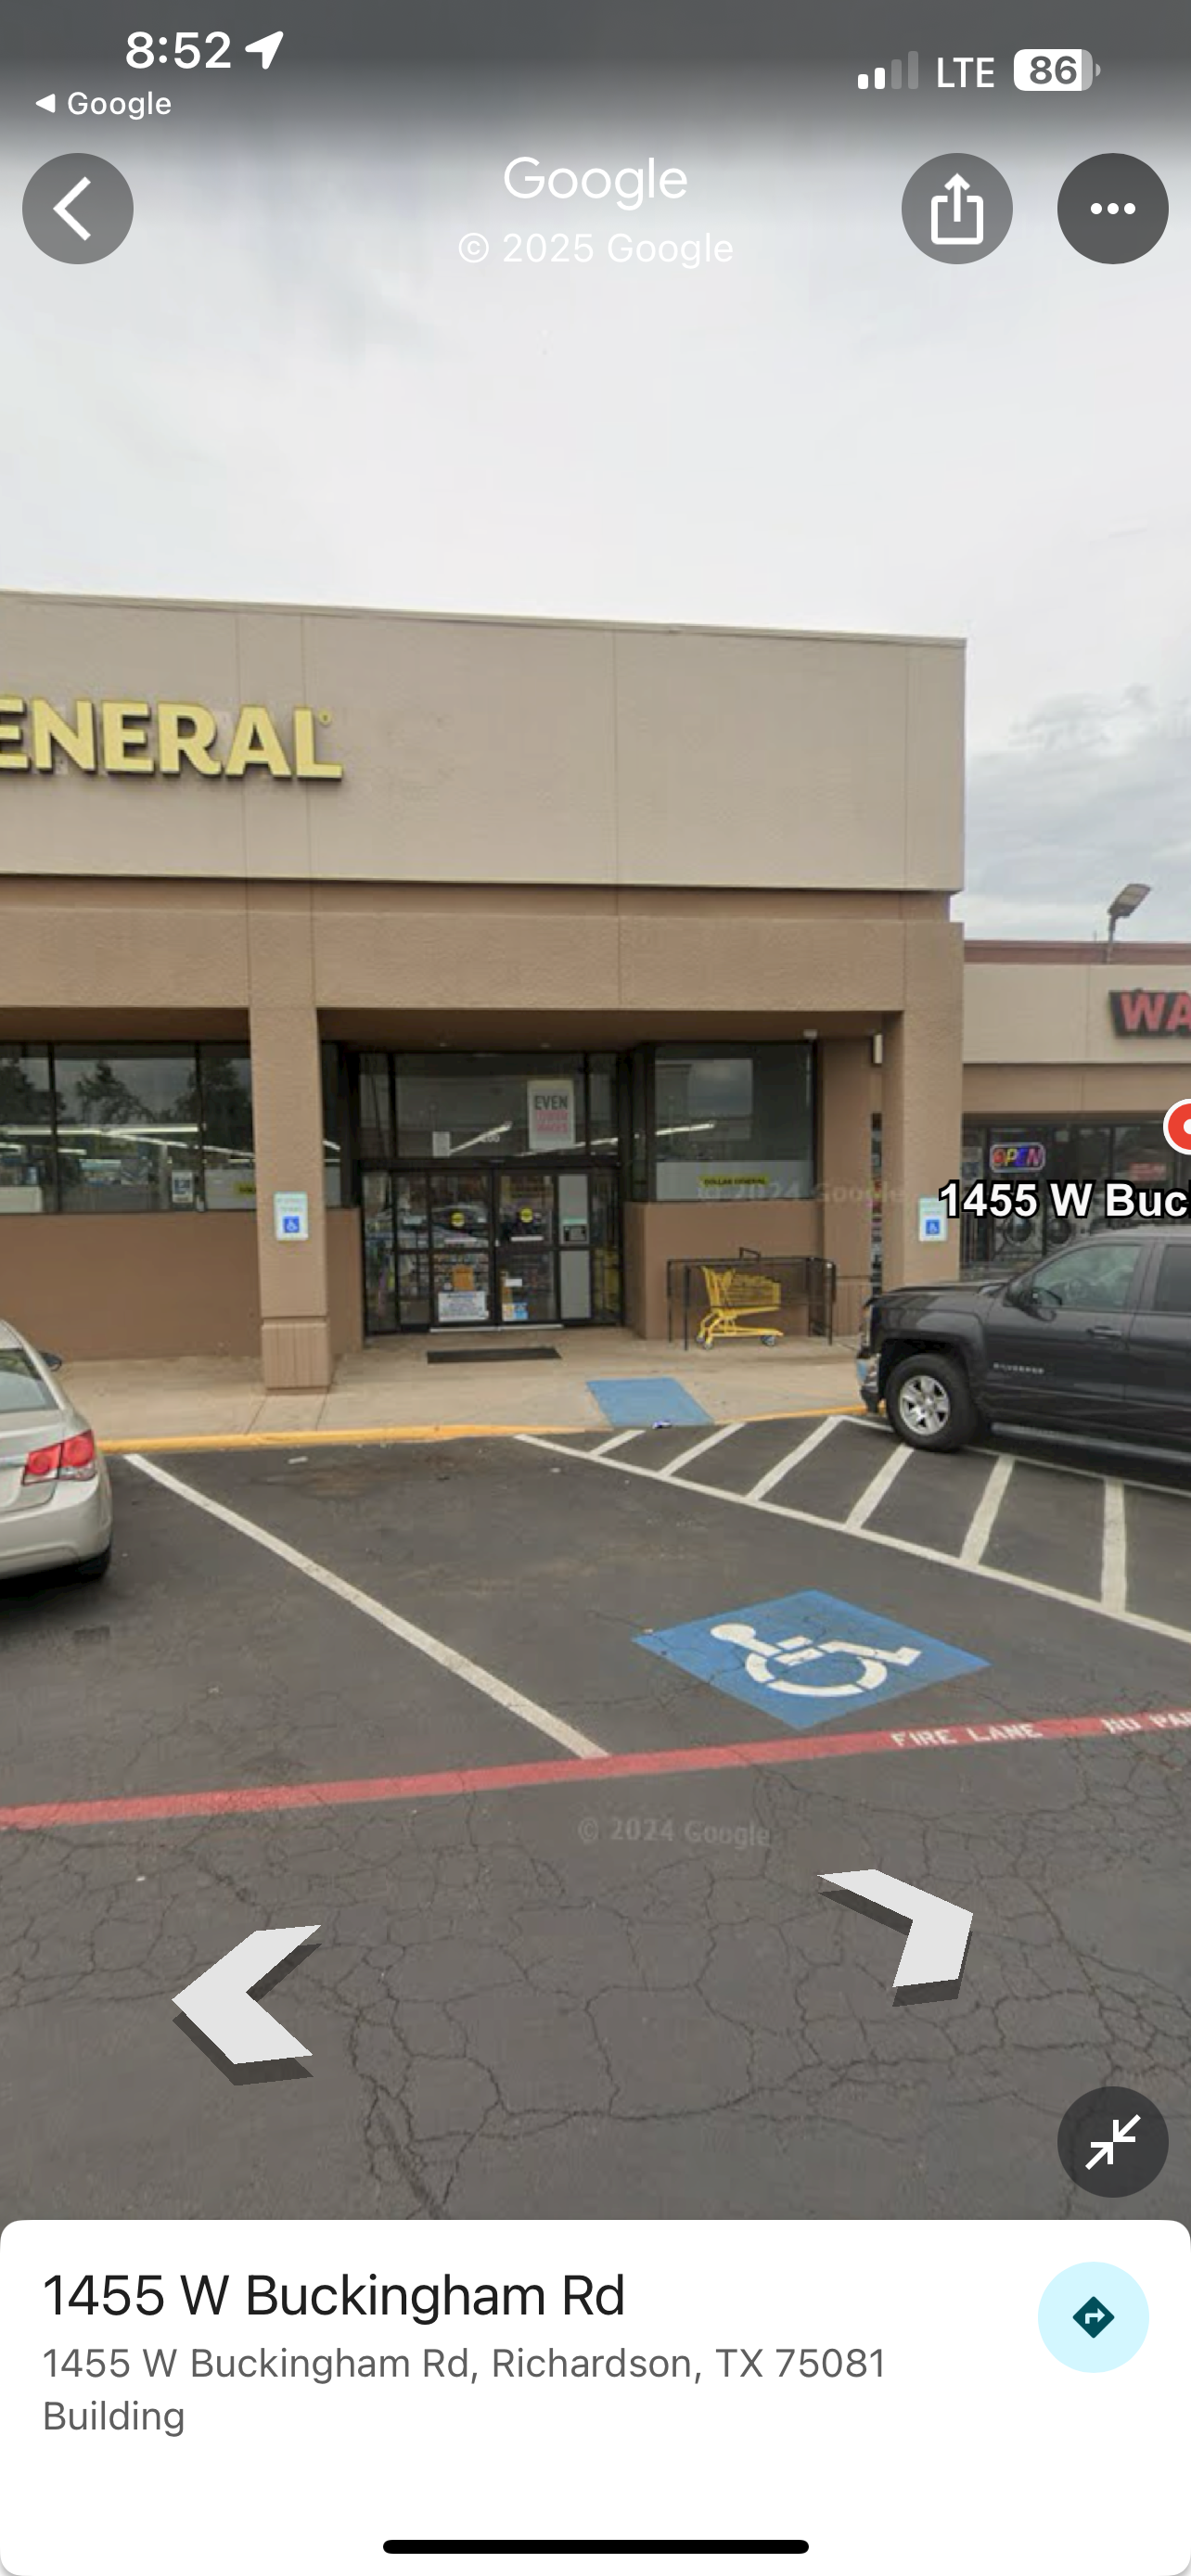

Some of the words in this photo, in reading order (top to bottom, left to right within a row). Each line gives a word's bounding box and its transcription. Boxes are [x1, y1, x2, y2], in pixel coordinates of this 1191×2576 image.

[1119, 991, 1191, 1032] WA
[534, 1095, 569, 1110] EVEN
[992, 1147, 1044, 1167] OPEN
[891, 1729, 959, 1747] FIRE
[967, 1724, 1043, 1741] LANE
